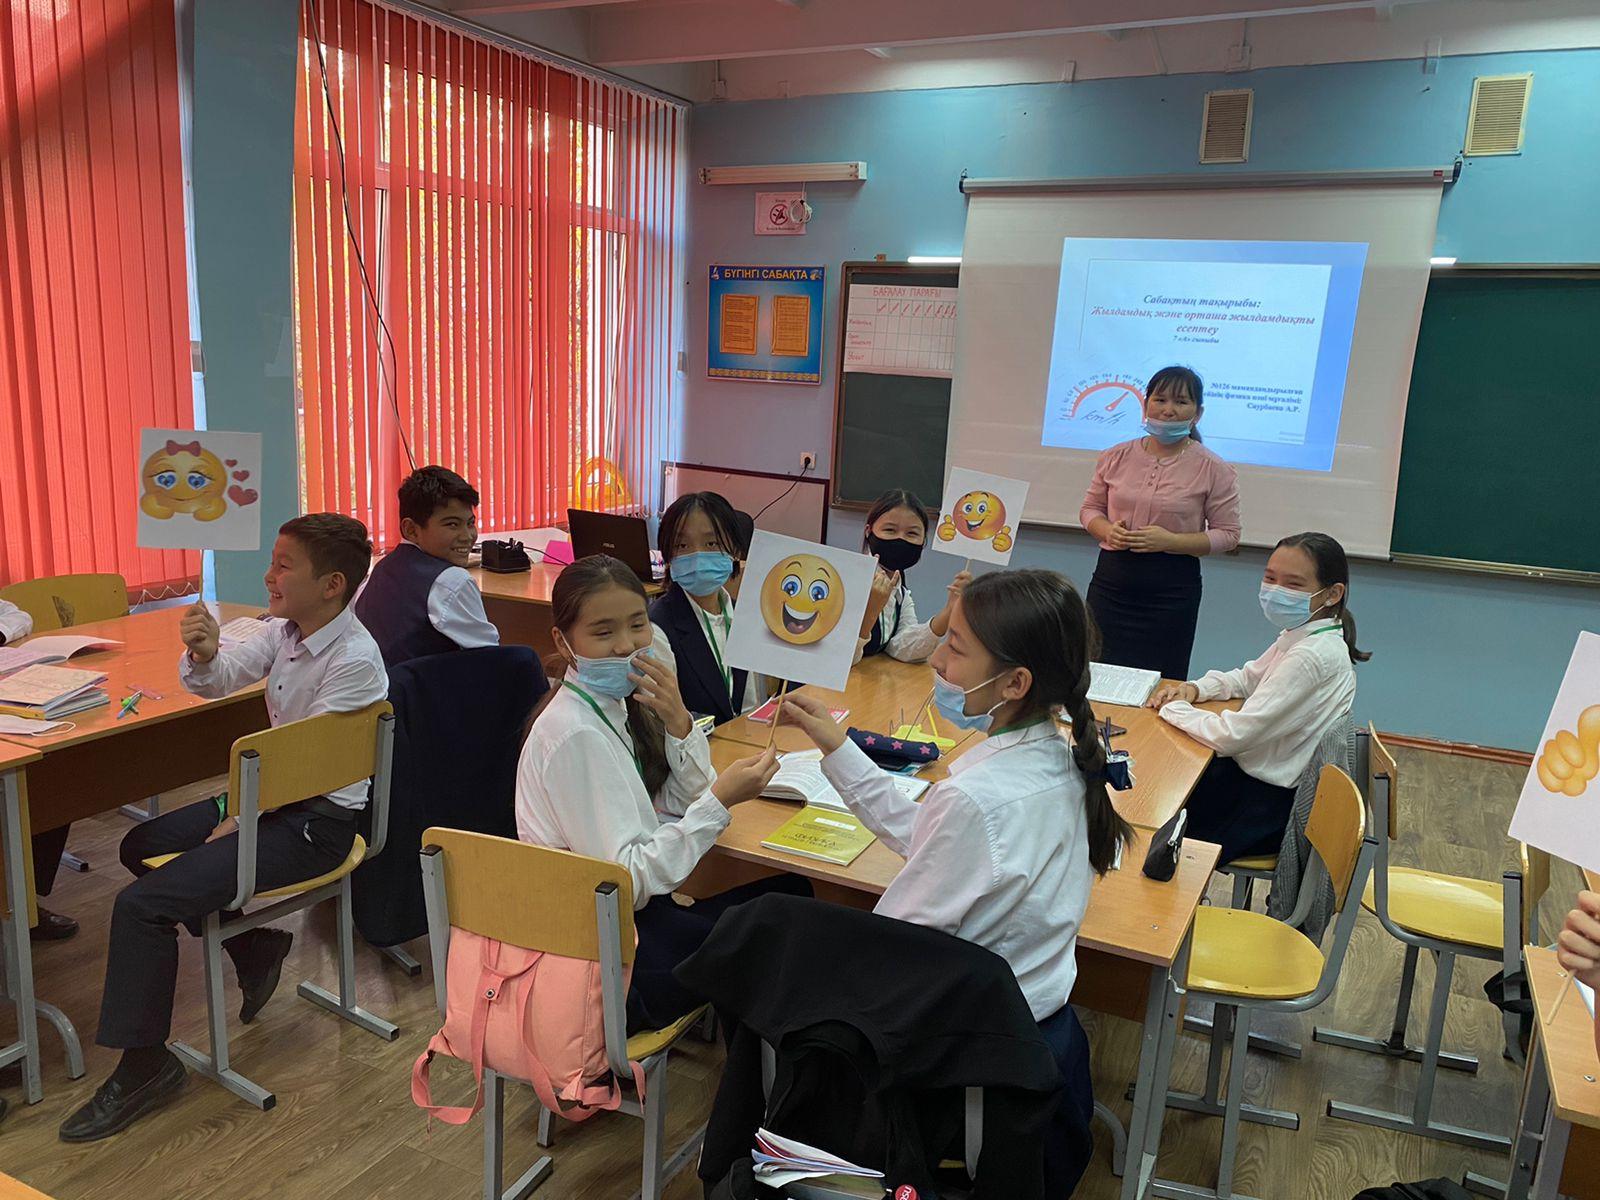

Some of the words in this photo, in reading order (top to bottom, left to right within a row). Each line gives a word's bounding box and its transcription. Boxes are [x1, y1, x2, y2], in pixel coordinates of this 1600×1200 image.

[724, 269, 760, 279] БҮГІНГІ
[761, 269, 808, 281] САБАҚТА
[1143, 294, 1197, 307] Сабақтың
[1198, 298, 1262, 309] тақырыбы:
[1091, 306, 1153, 319] Жылдамдық
[1154, 310, 1183, 319] және
[1184, 311, 1227, 322] орташа
[1228, 312, 1316, 325] жылдамдықты
[1176, 324, 1220, 336] есептеу
